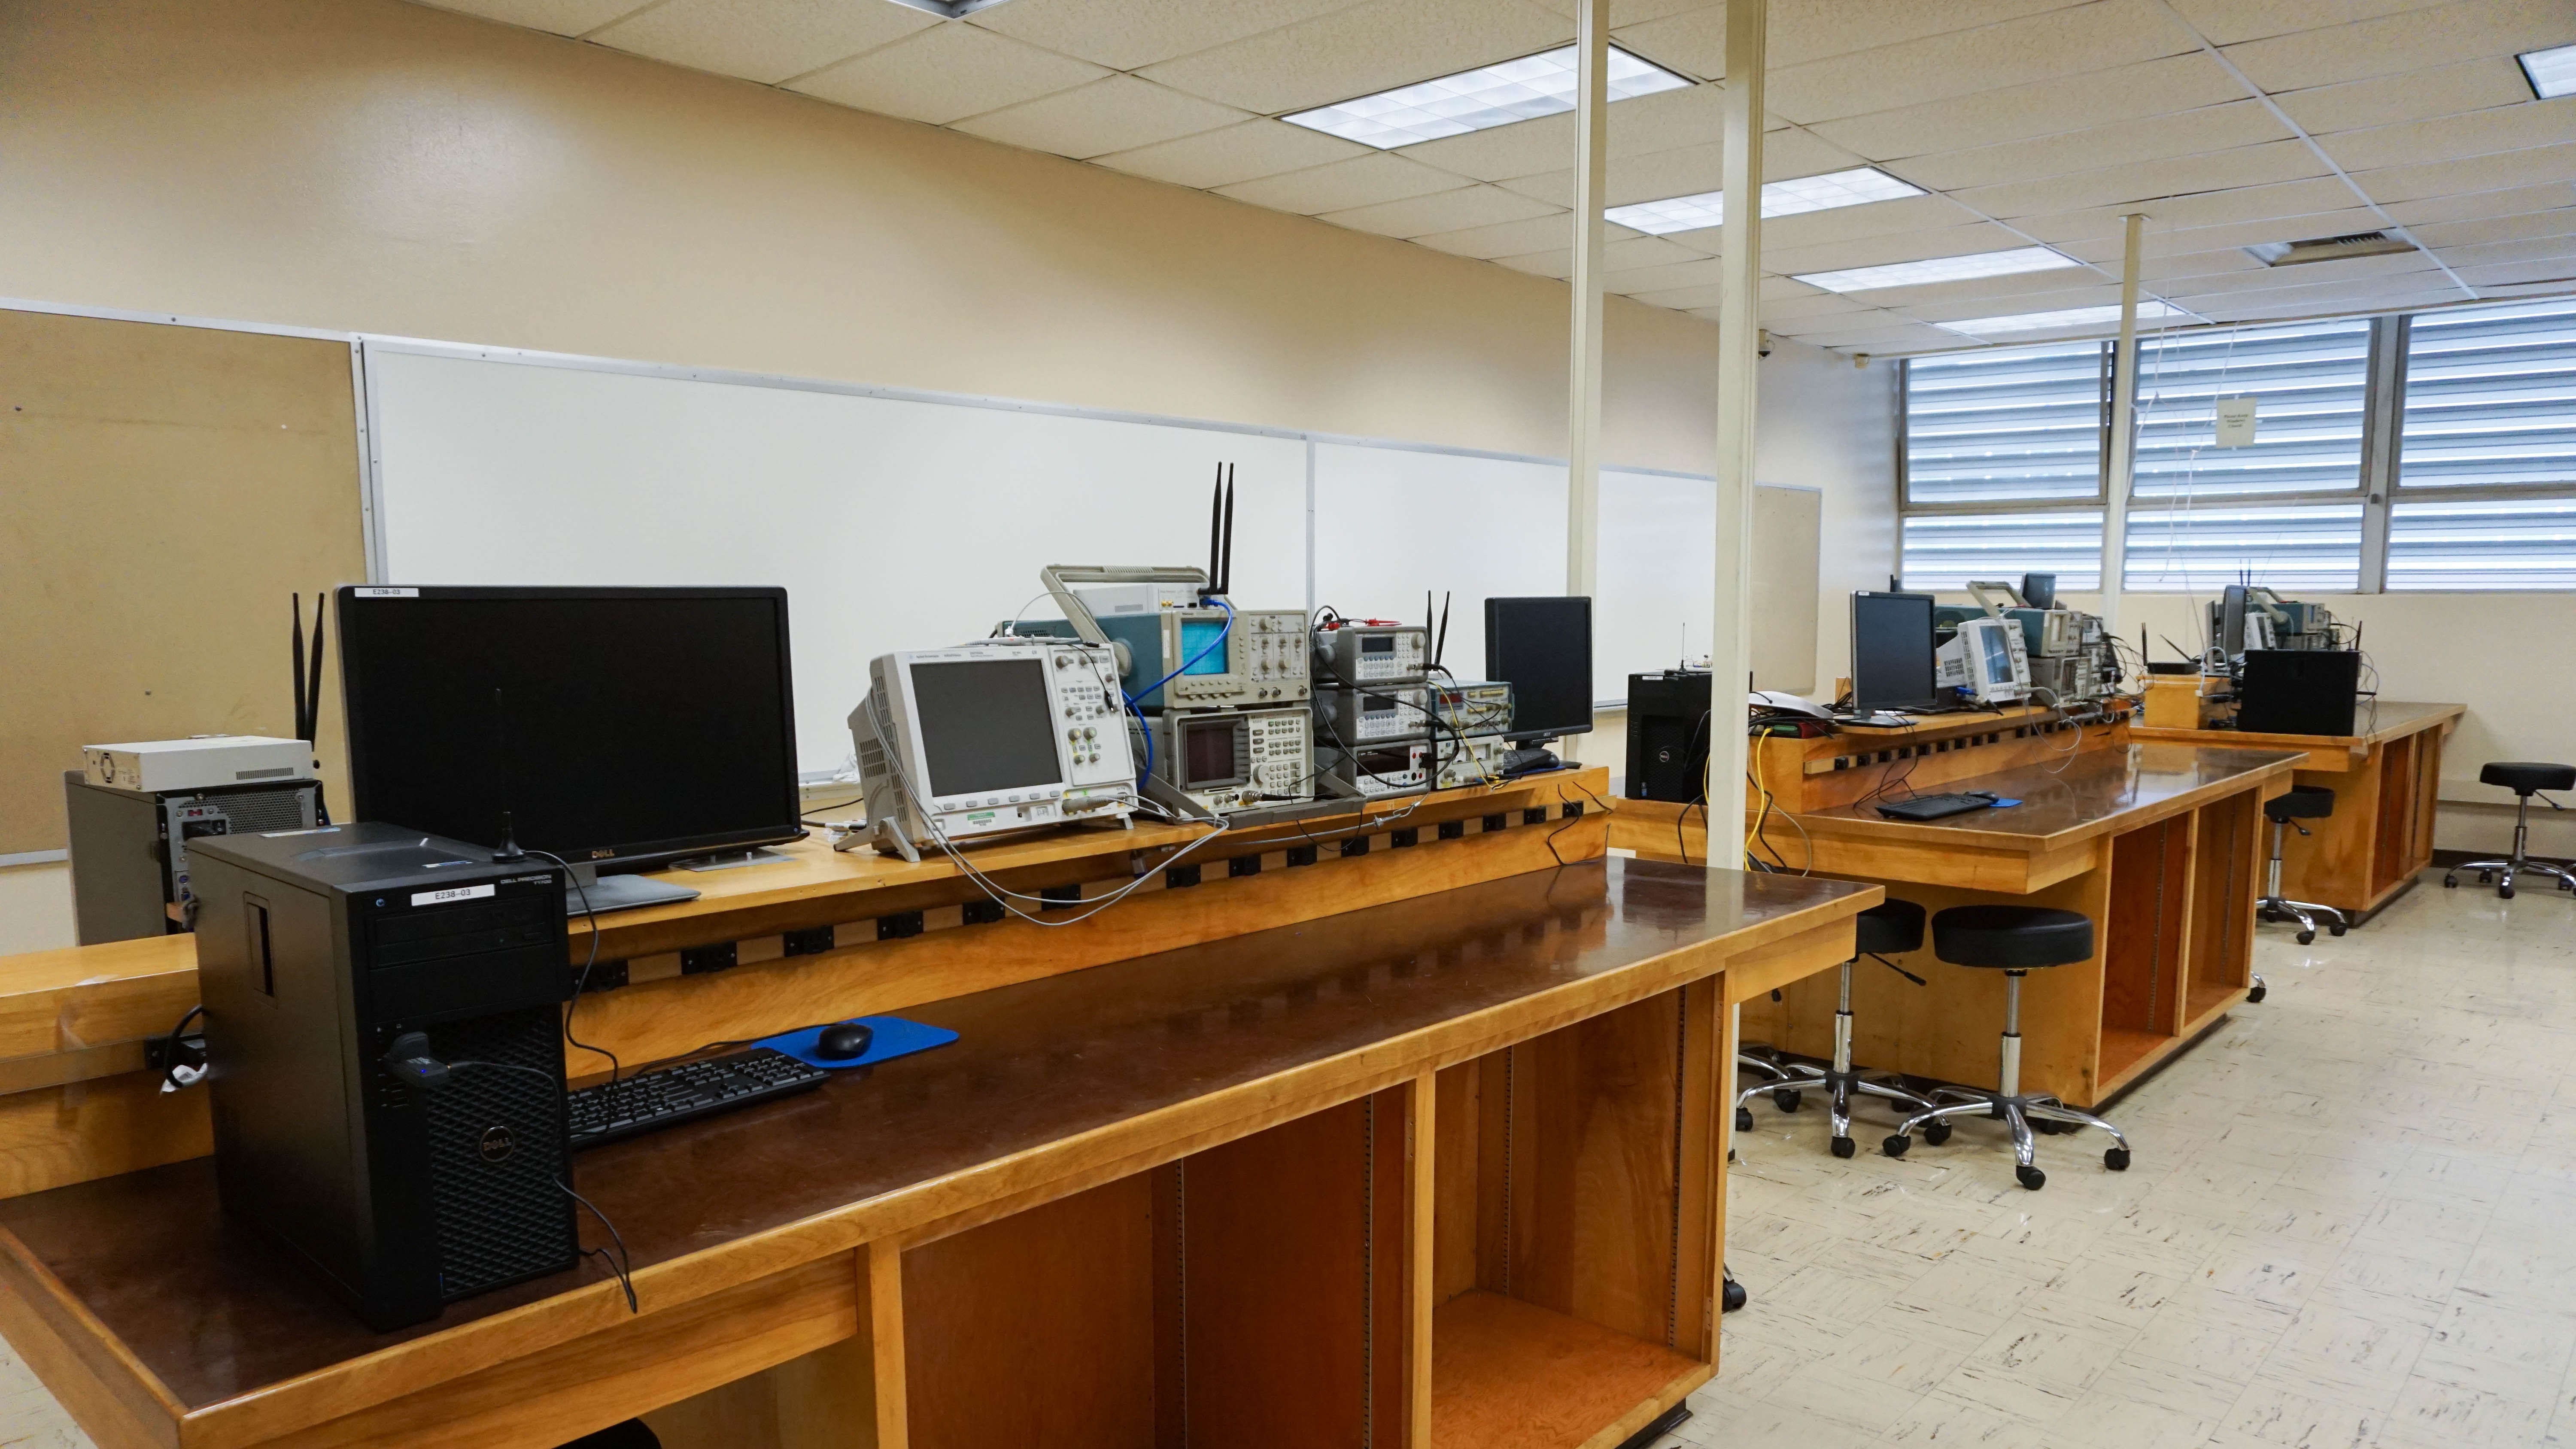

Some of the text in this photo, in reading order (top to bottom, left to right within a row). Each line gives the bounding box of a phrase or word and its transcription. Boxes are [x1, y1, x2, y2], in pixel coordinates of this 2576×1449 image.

[592, 849, 615, 858] DELL
[434, 889, 471, 899] E238-03
[483, 1137, 512, 1151] DELL
